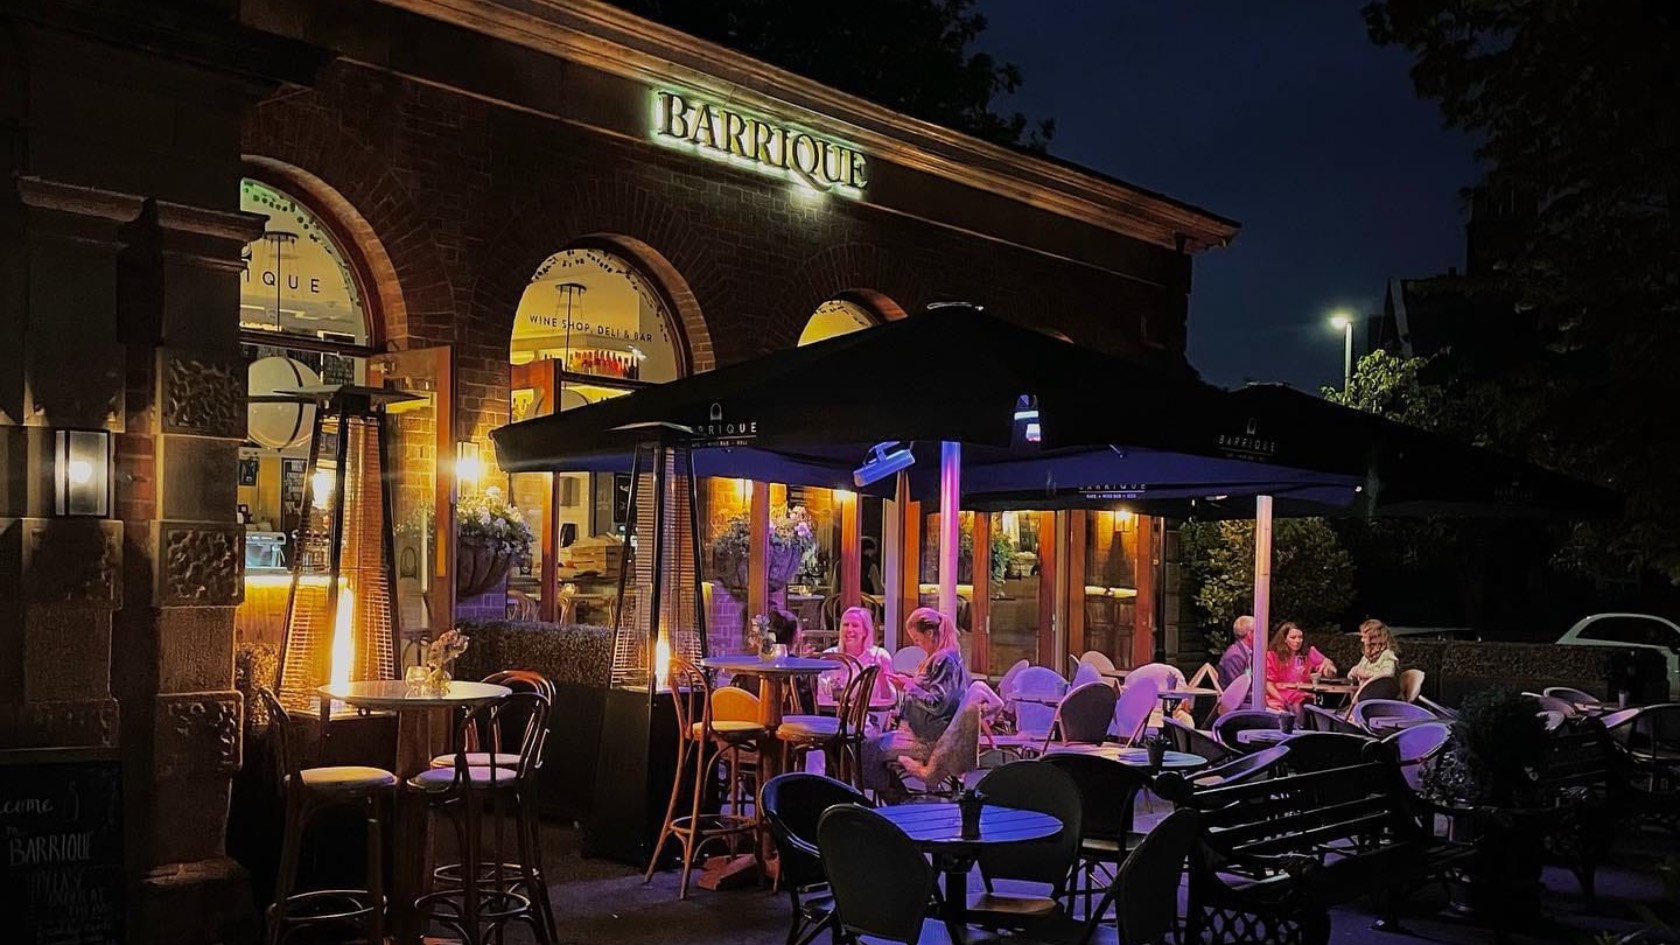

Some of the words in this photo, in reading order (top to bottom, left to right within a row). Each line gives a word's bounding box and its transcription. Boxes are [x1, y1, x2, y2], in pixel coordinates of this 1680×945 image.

[657, 91, 869, 191] BARRIQUE
[529, 314, 558, 328] WINE
[597, 325, 620, 337] DELI
[623, 330, 630, 340] &
[634, 333, 653, 343] BAR
[9, 831, 94, 867] BARRIQUE
